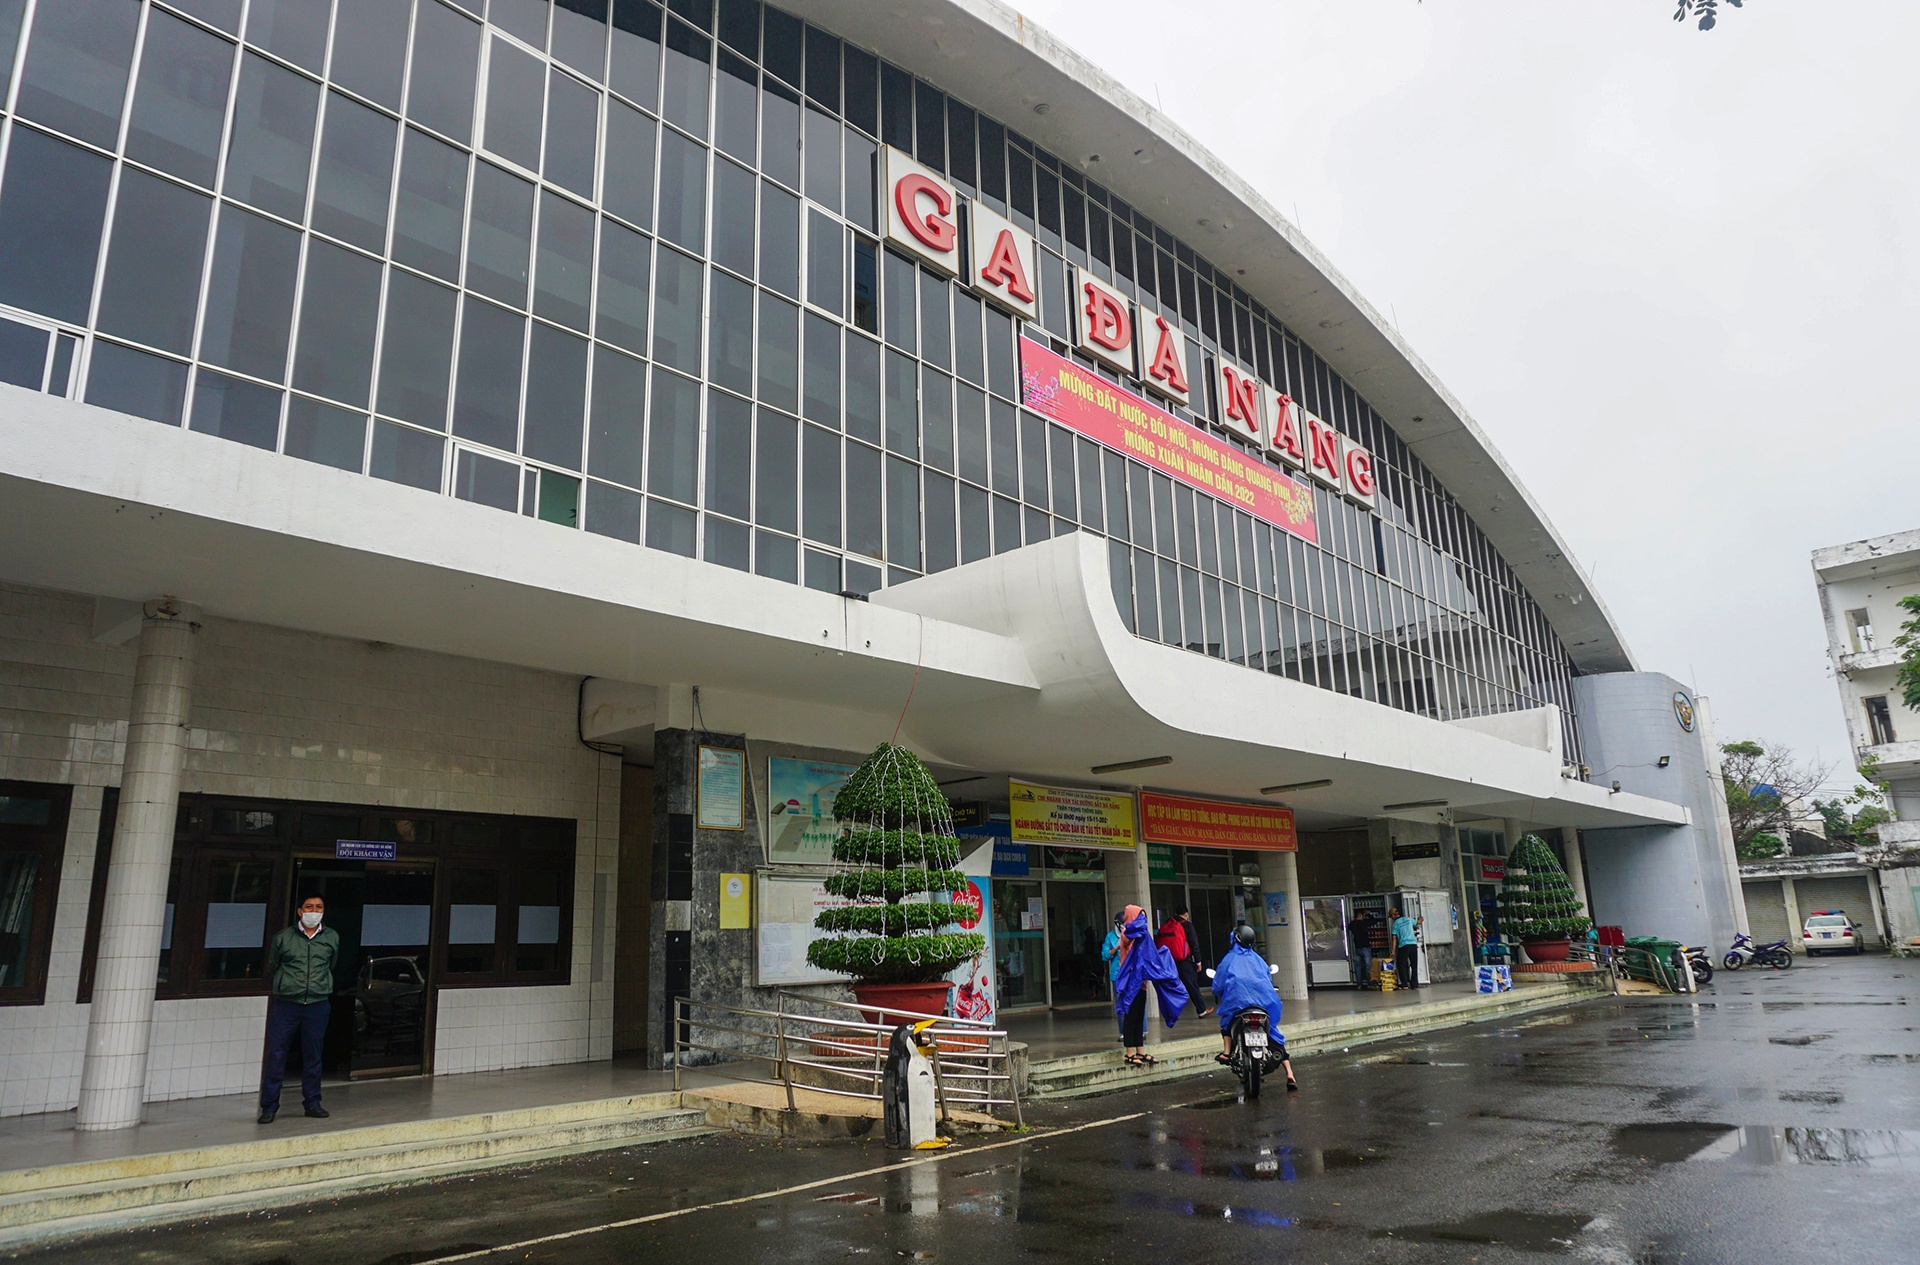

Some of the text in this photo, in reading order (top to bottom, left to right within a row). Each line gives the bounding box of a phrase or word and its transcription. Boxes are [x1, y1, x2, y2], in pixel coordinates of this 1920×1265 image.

[894, 173, 1034, 304] GA
[1083, 281, 1189, 394] ĐÀ
[1058, 369, 1291, 501] MỪNG ĐẤT NƯỚC ĐỔI MỚI, MỪNG ĐẢNG QUANG VINH
[1124, 428, 1255, 507] MỪNG XUÂN NHÂM DẦN 2022
[340, 848, 393, 859] ĐỘI KHÁCH VẬN
